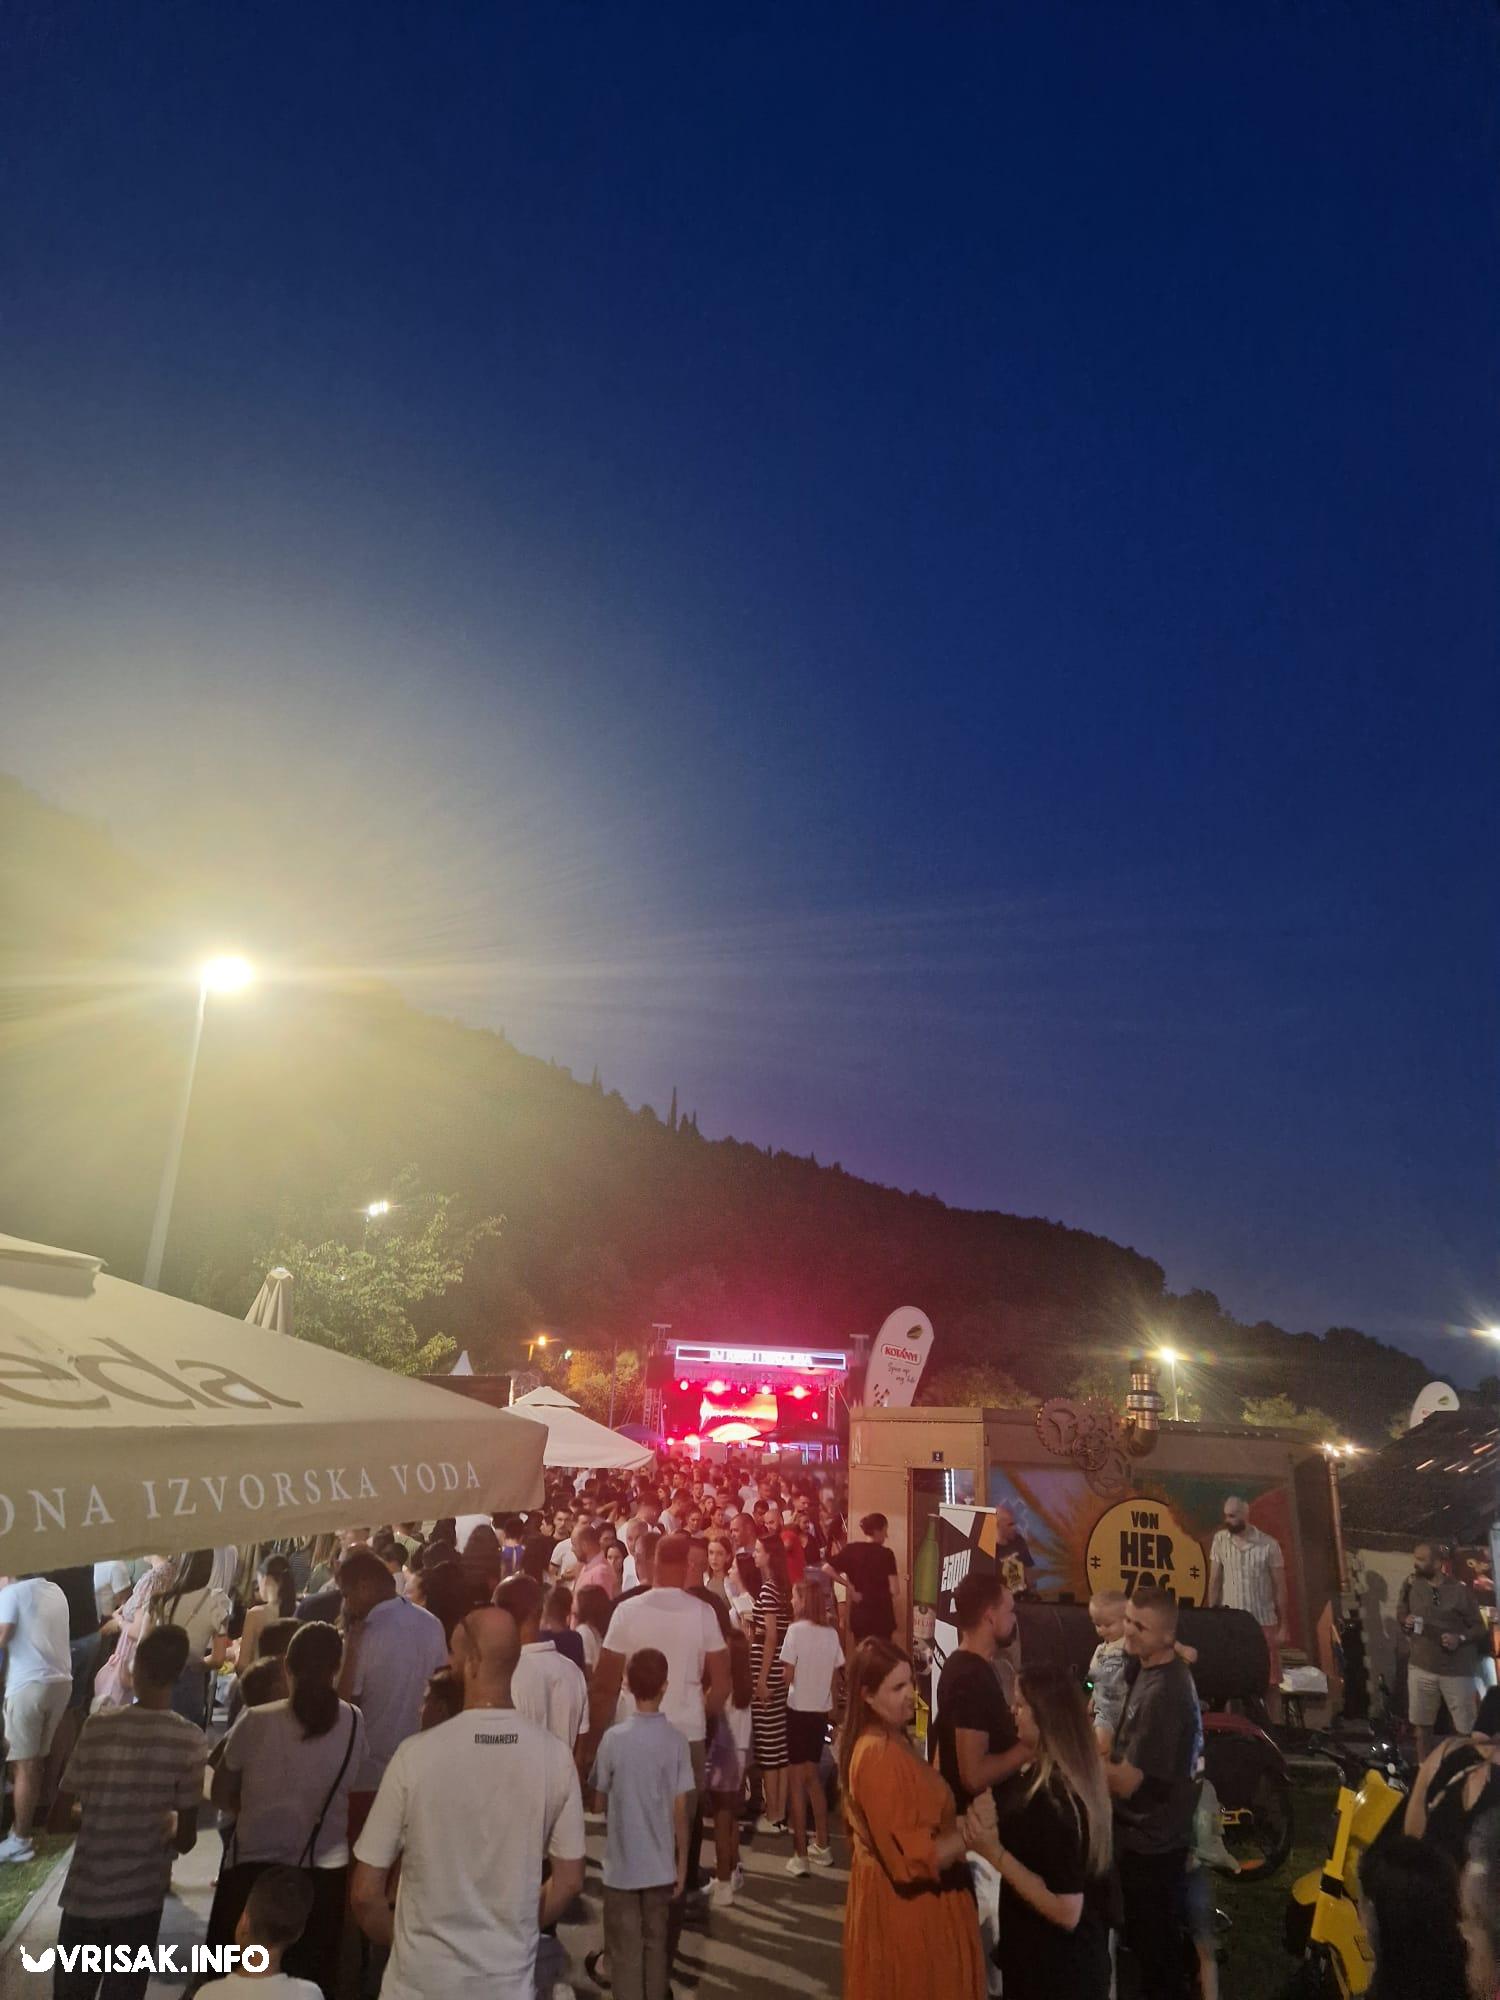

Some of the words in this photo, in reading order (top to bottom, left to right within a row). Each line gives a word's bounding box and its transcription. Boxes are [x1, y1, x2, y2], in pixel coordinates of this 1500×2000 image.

[142, 1467, 378, 1519] IZVORSKA
[389, 1460, 480, 1496] VODA
[1131, 1510, 1159, 1529] VON
[1120, 1531, 1175, 1571] HER
